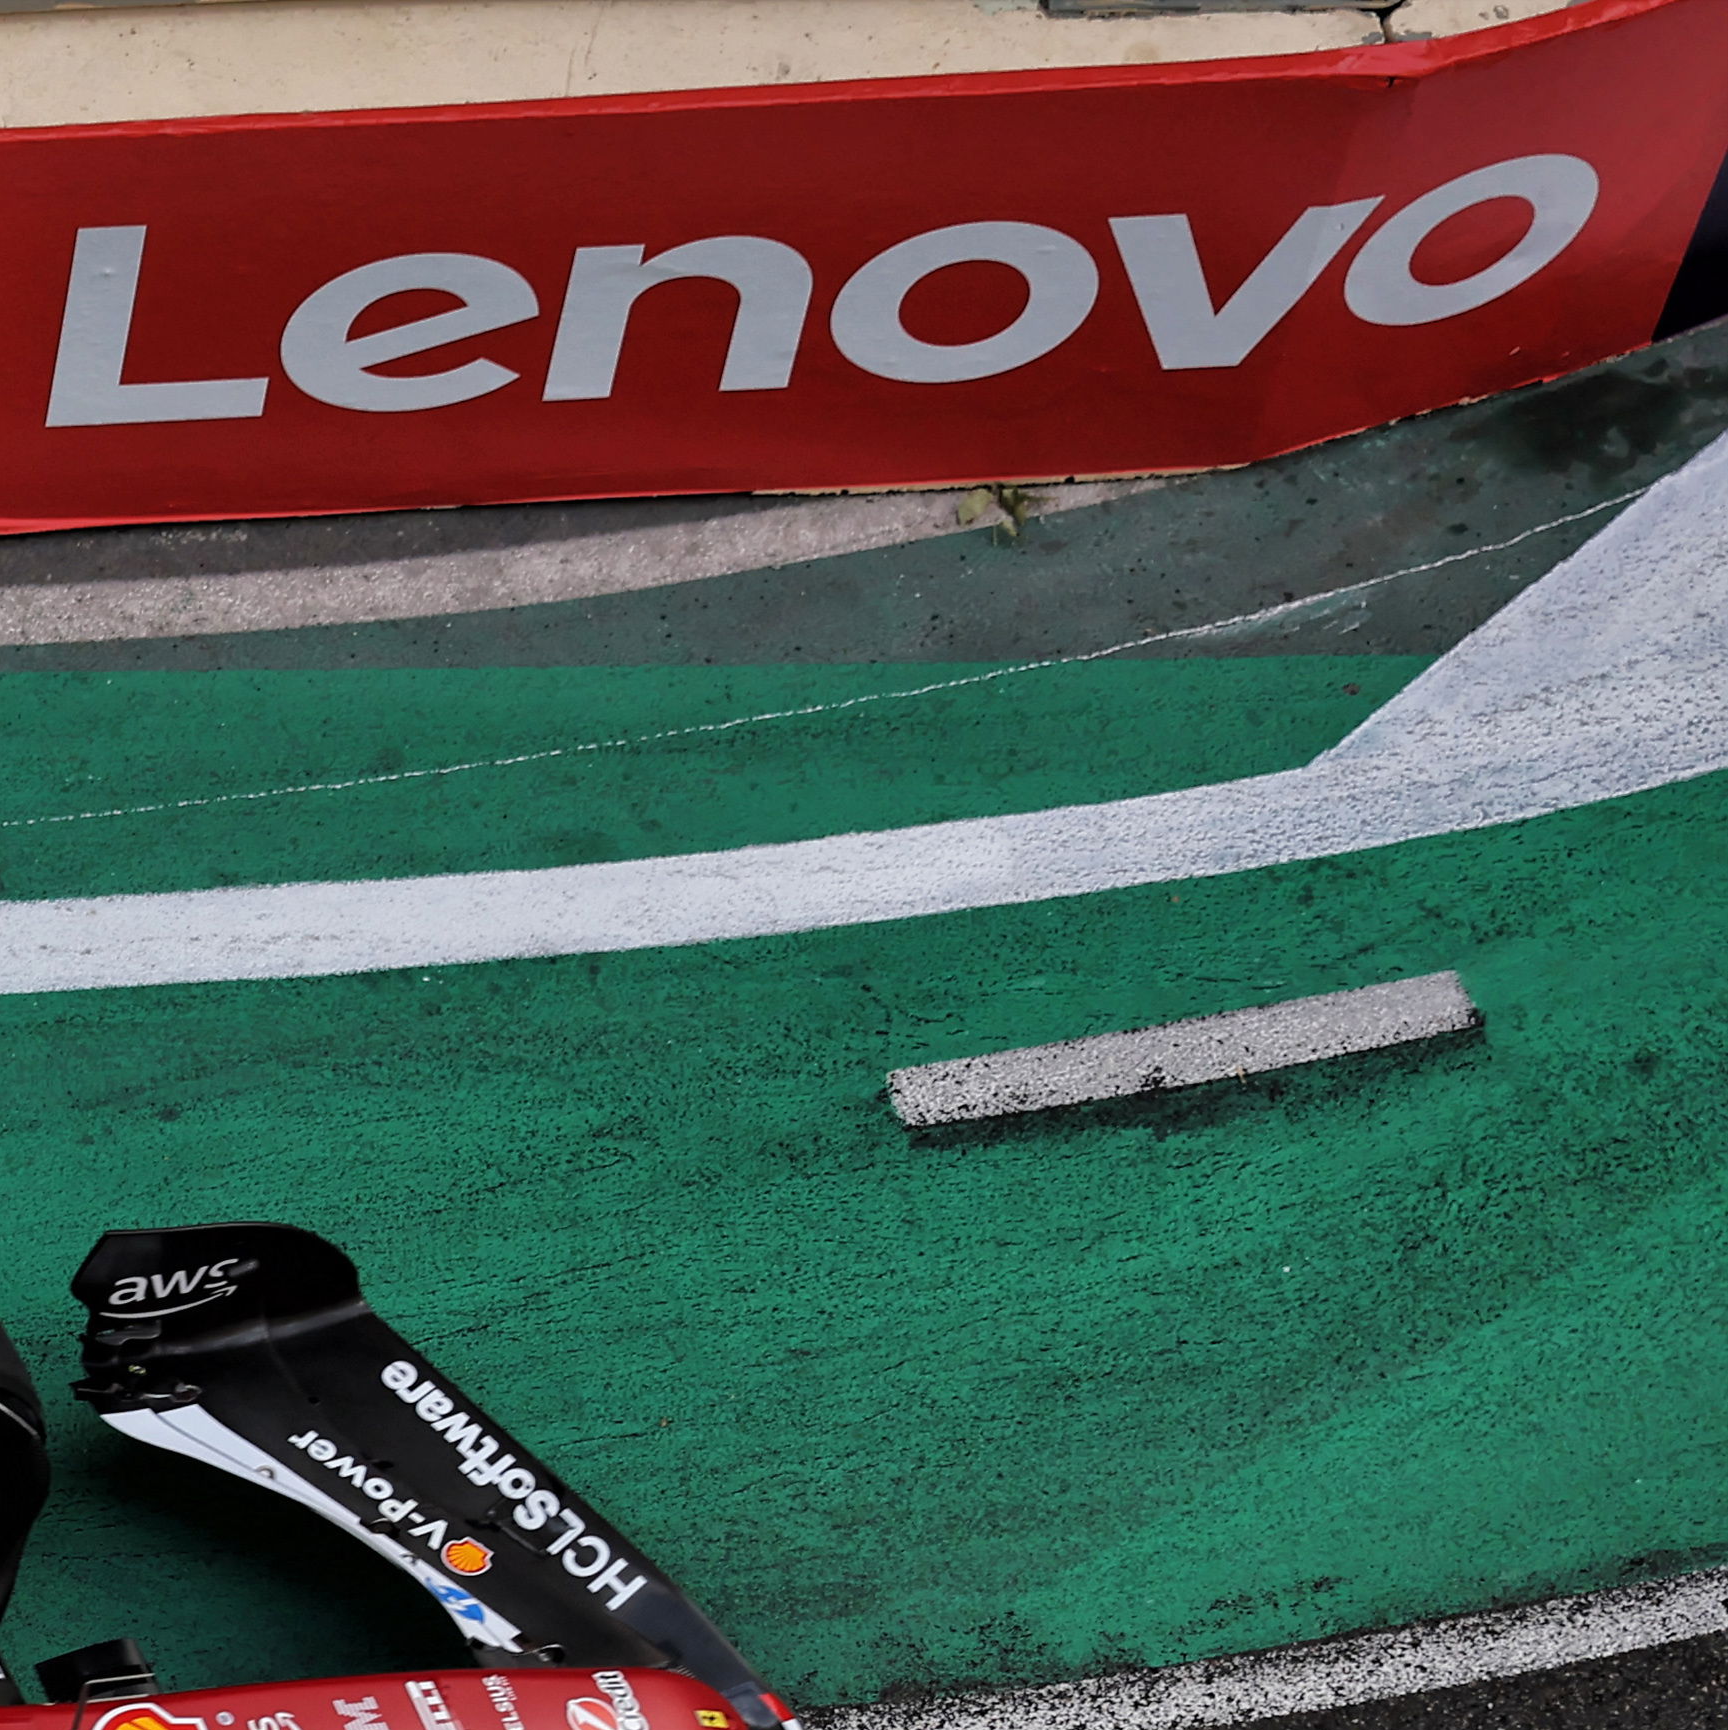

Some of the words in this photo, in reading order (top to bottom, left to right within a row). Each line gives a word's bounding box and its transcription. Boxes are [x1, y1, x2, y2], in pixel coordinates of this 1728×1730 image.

[46, 153, 1600, 428] Lenovo
[288, 1429, 449, 1552] V-Power
[380, 1359, 647, 1611] HCLSoftware
